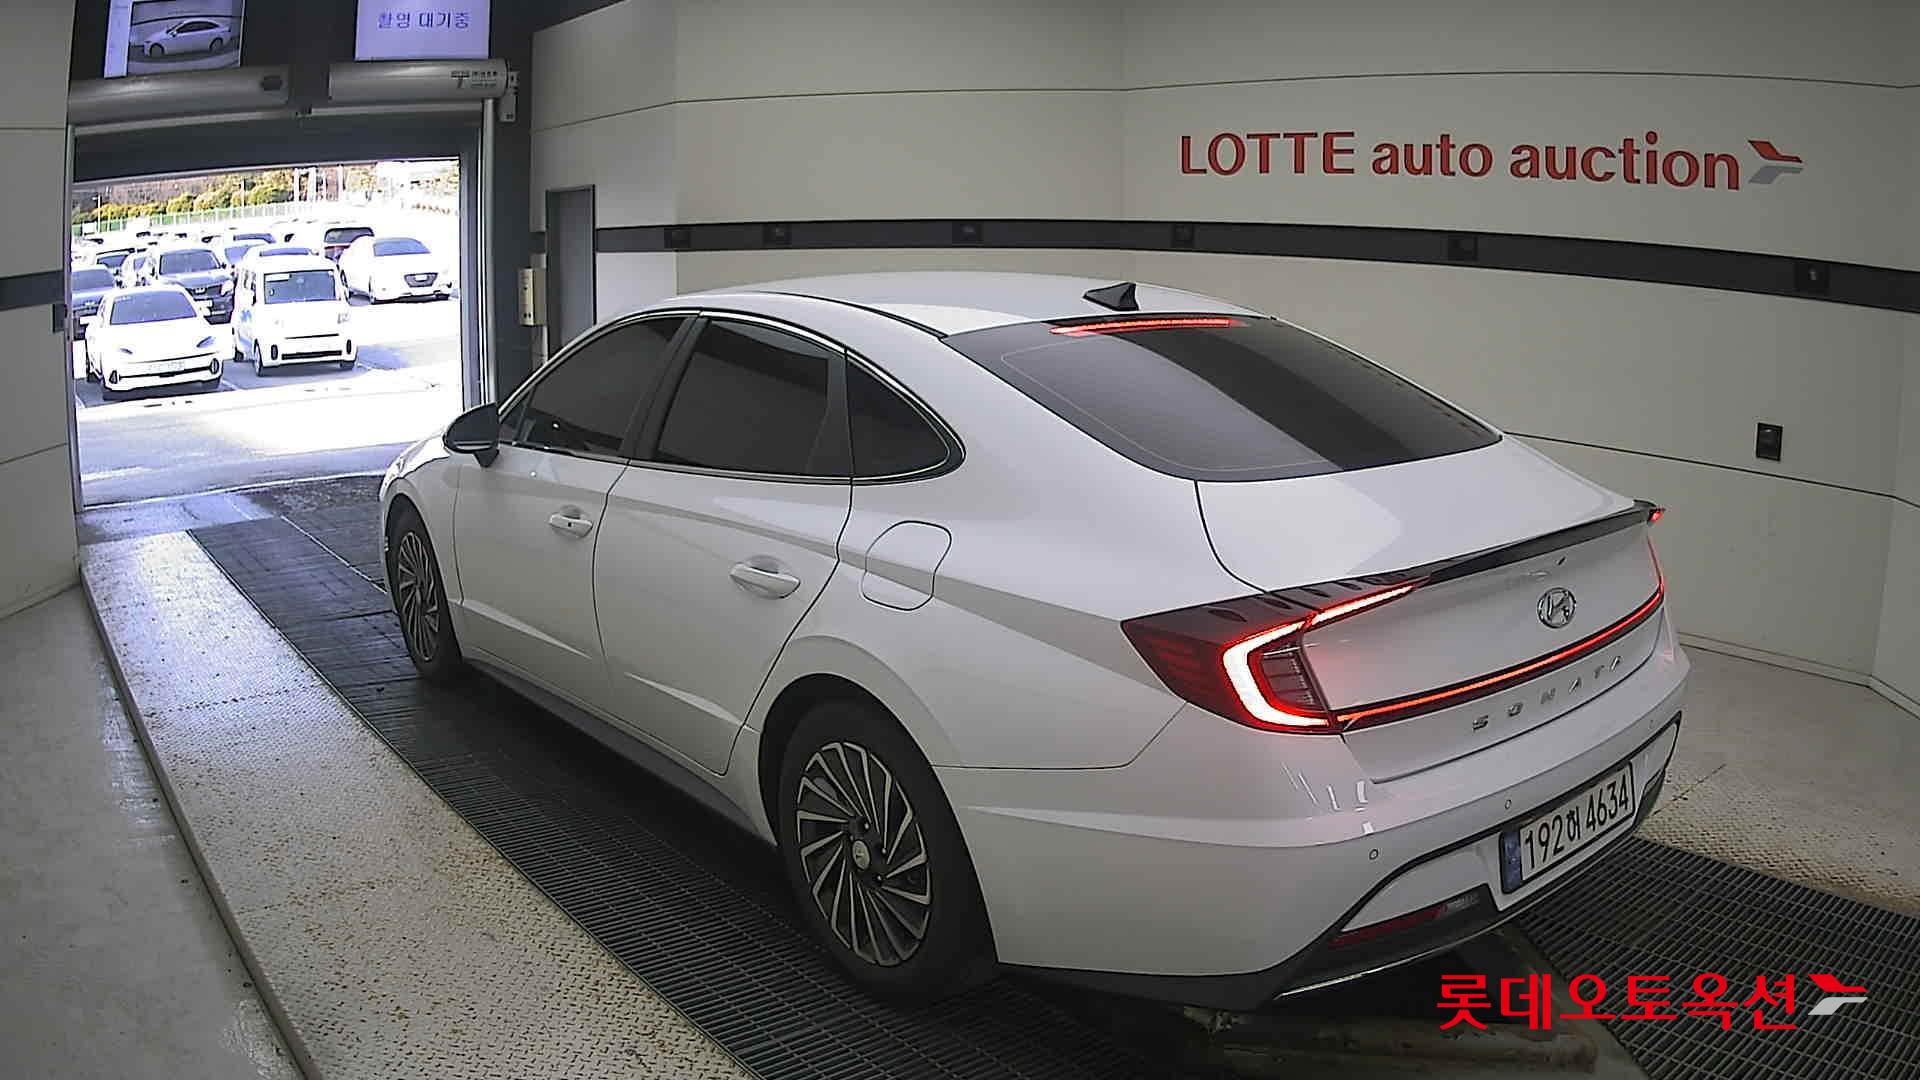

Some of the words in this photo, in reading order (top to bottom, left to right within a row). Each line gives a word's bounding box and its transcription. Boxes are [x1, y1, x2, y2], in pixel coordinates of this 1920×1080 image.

[418, 12, 470, 29] 대기중
[1181, 131, 1355, 175] LOTTE
[1371, 134, 1493, 177] auto
[1509, 131, 1740, 190] auction
[1472, 655, 1622, 732] SONATA
[1525, 805, 1581, 869] 192허
[1586, 774, 1629, 831] 4634
